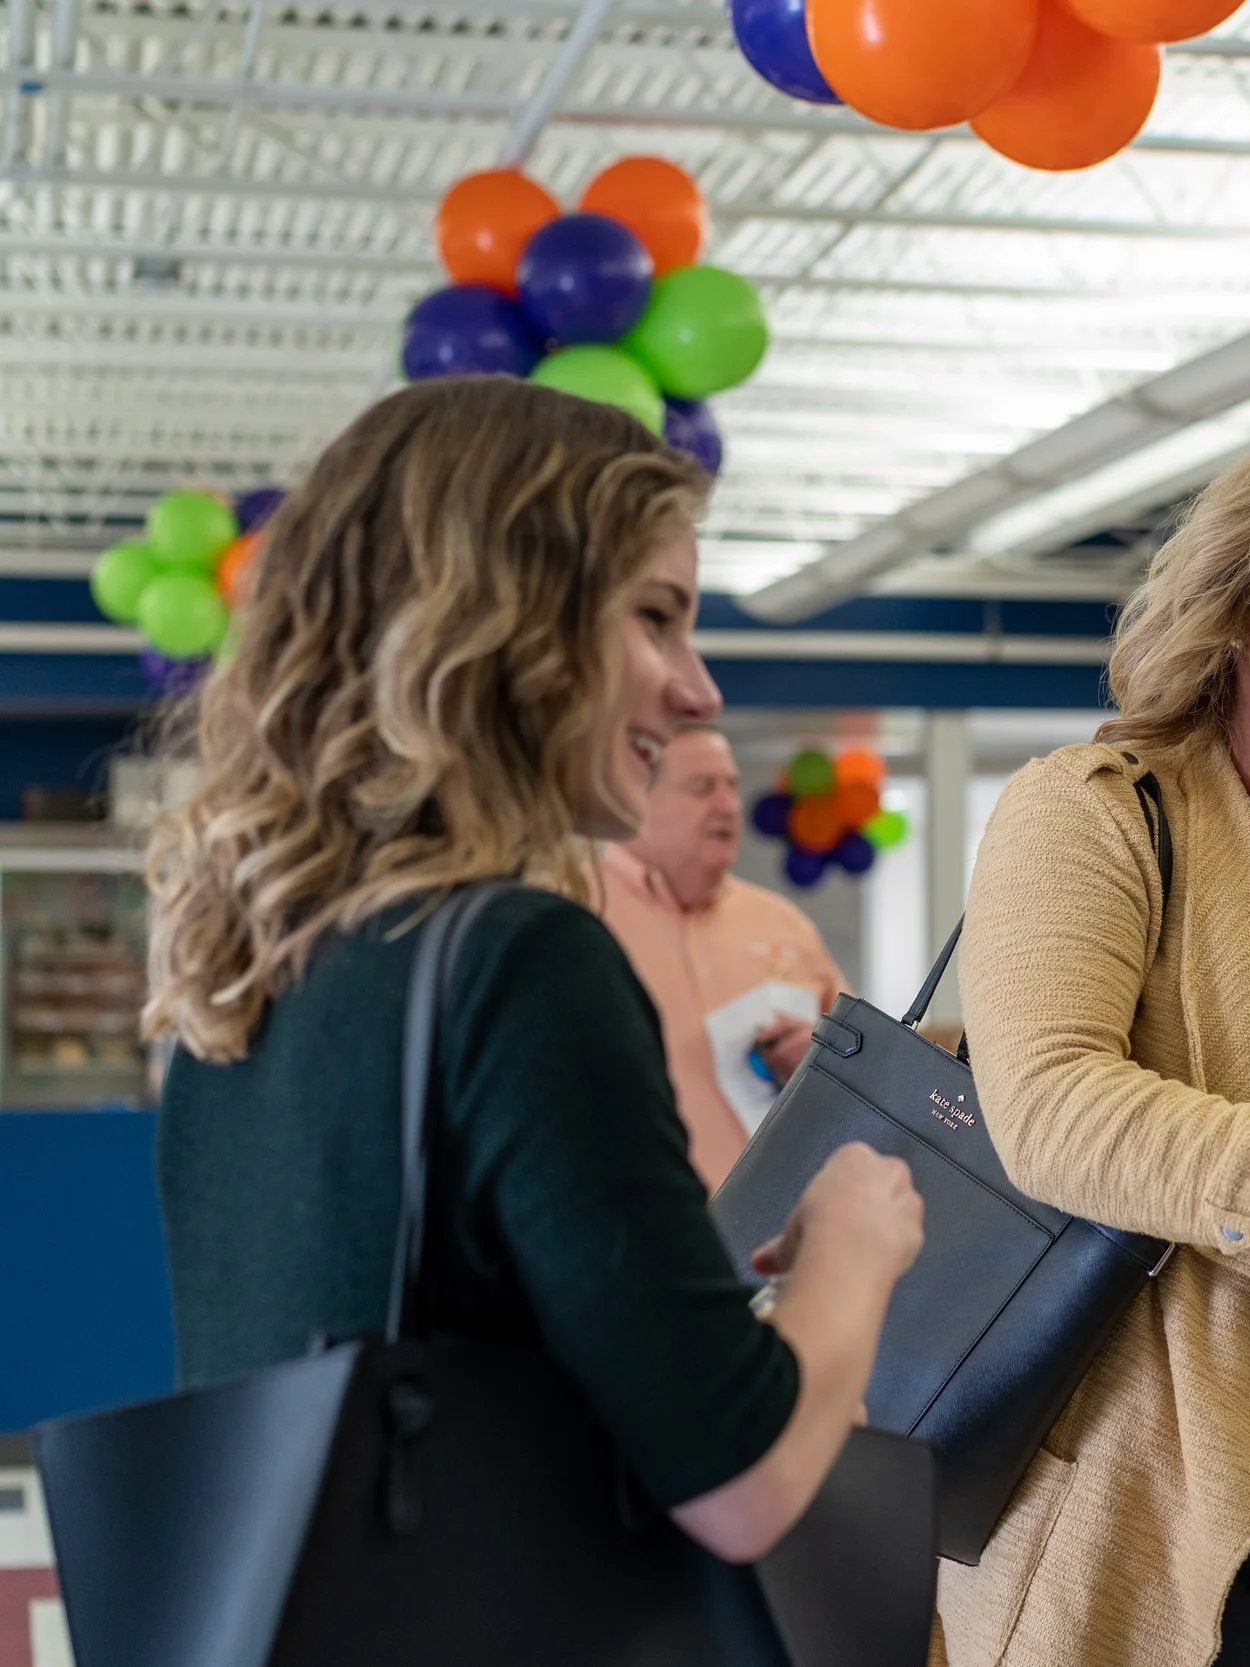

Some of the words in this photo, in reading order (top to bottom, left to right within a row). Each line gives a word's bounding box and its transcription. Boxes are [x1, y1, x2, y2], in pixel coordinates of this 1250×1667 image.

[929, 1088, 950, 1109] kate
[949, 1105, 975, 1127] spade
[931, 1109, 945, 1120] NEW
[943, 1117, 959, 1130] YORK
